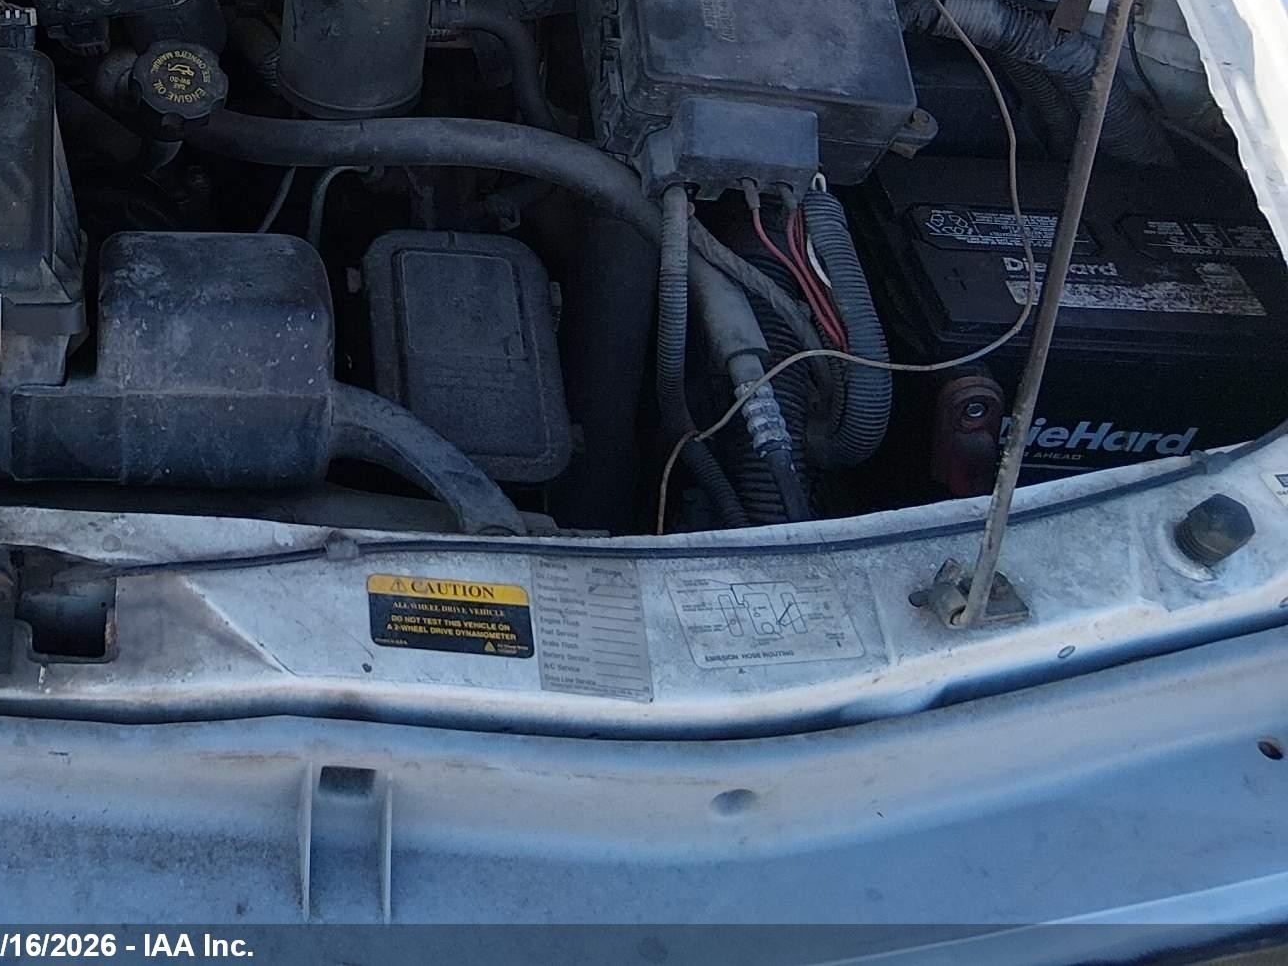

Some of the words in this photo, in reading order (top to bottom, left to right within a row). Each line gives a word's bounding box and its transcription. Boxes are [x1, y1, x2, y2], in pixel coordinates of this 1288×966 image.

[152, 78, 167, 94] OIL
[166, 87, 207, 104] ENGINE
[1002, 257, 1118, 276] Dieard
[411, 580, 495, 599] CAUTION
[392, 602, 410, 610] ALL
[410, 603, 441, 612] WHEEL
[442, 606, 467, 614] DRIVE
[469, 608, 506, 617] VEHICLE
[391, 614, 403, 622] DO
[404, 616, 420, 624] NOT
[422, 617, 442, 625] TEST
[444, 619, 462, 627] THIS
[463, 621, 496, 631] VEHICLE
[498, 624, 510, 632] ON
[430, 627, 454, 636] DRIVE
[455, 629, 517, 640] DYNAMOMETER
[742, 650, 762, 660] HOSE
[762, 649, 795, 658] ROUTING
